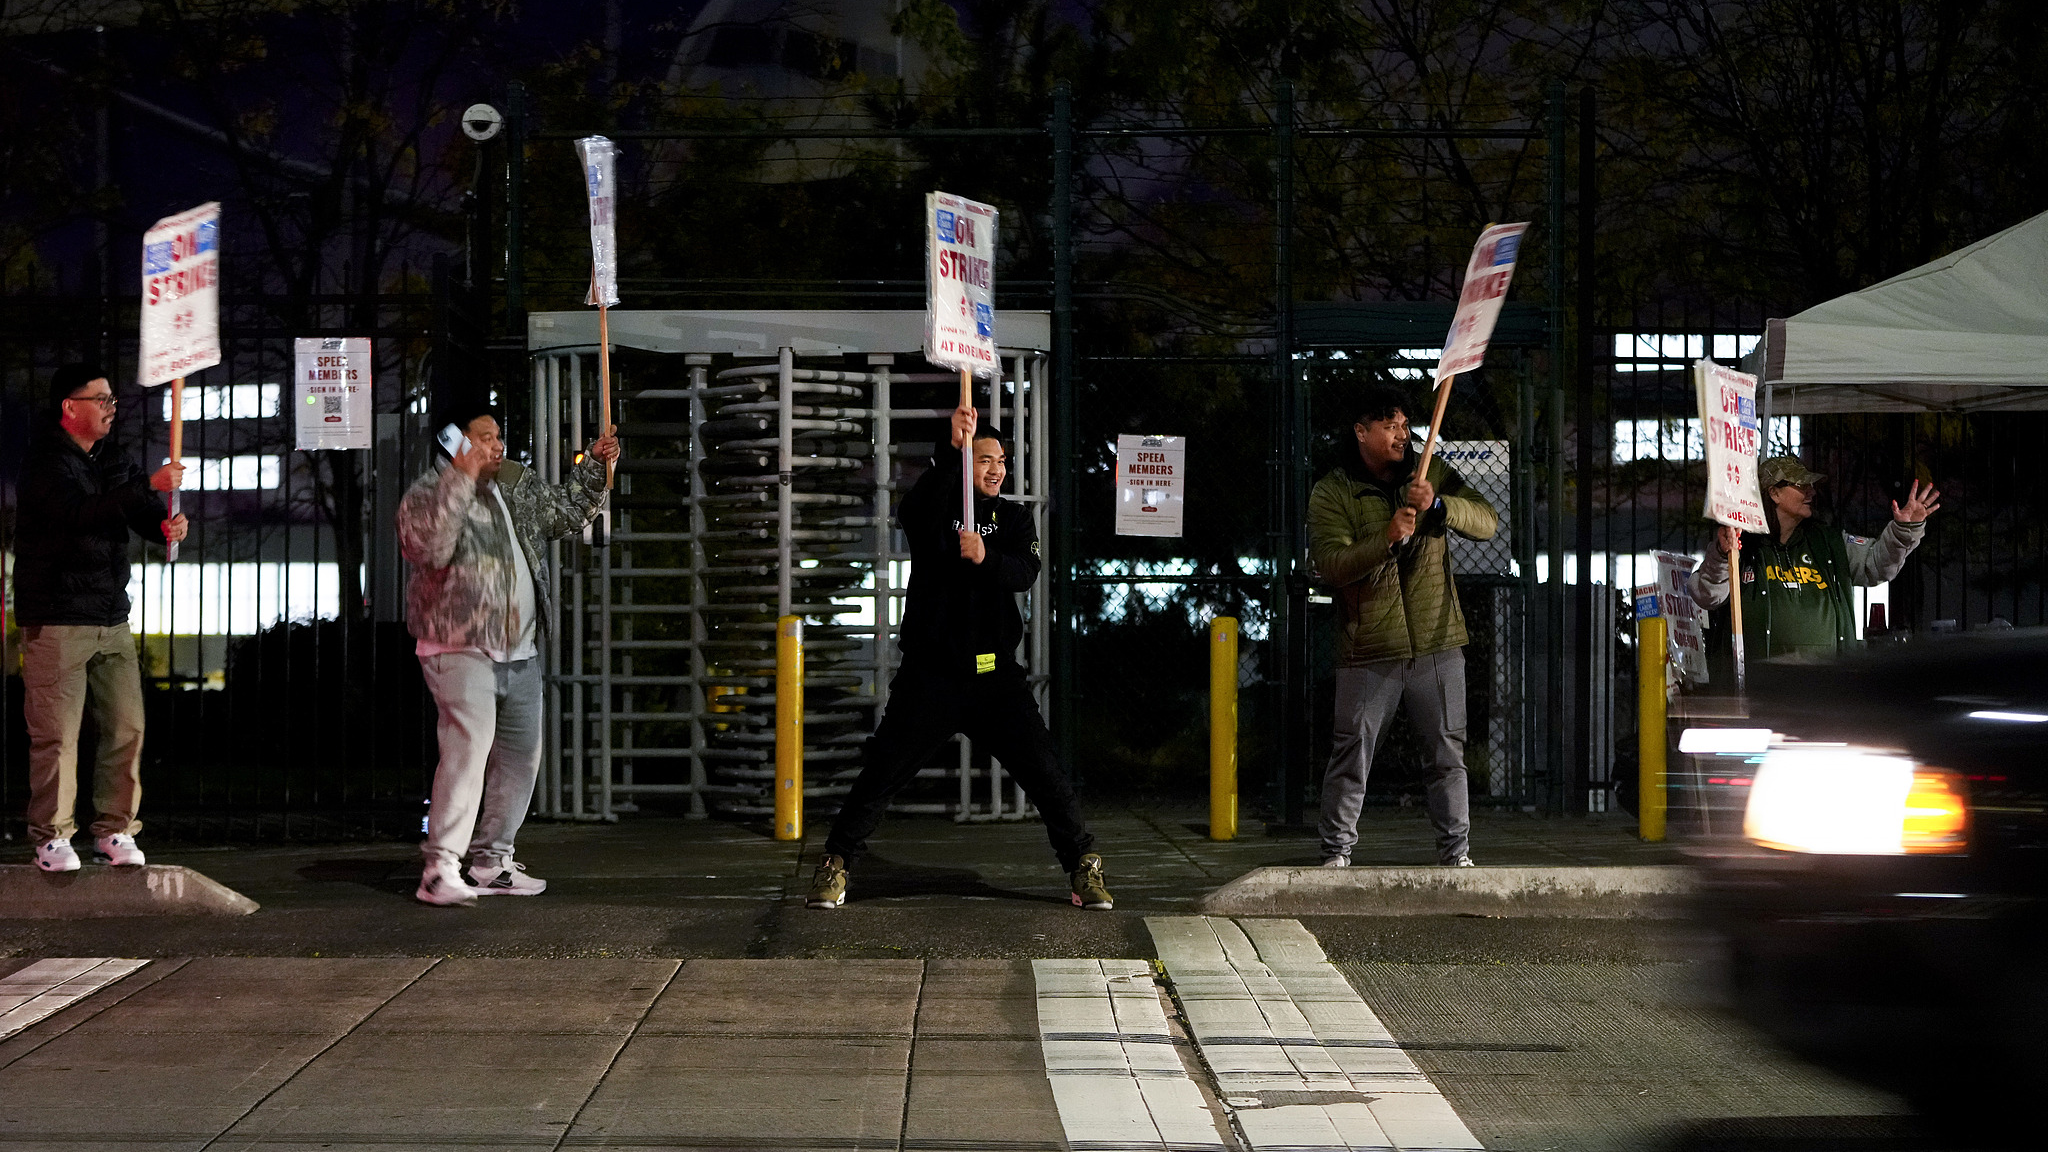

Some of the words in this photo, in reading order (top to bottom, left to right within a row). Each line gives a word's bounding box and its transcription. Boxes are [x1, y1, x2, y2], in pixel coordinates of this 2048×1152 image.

[955, 214, 975, 248] ON
[940, 248, 990, 288] STRIKE
[941, 340, 954, 352] AT
[959, 342, 992, 362] BOEING
[1710, 416, 1754, 457] STRIKE
[1137, 452, 1165, 463] SPEEA
[1434, 450, 1492, 460] OEING
[1129, 464, 1173, 475] MEMBERS
[1766, 564, 1823, 585] ACKERS
